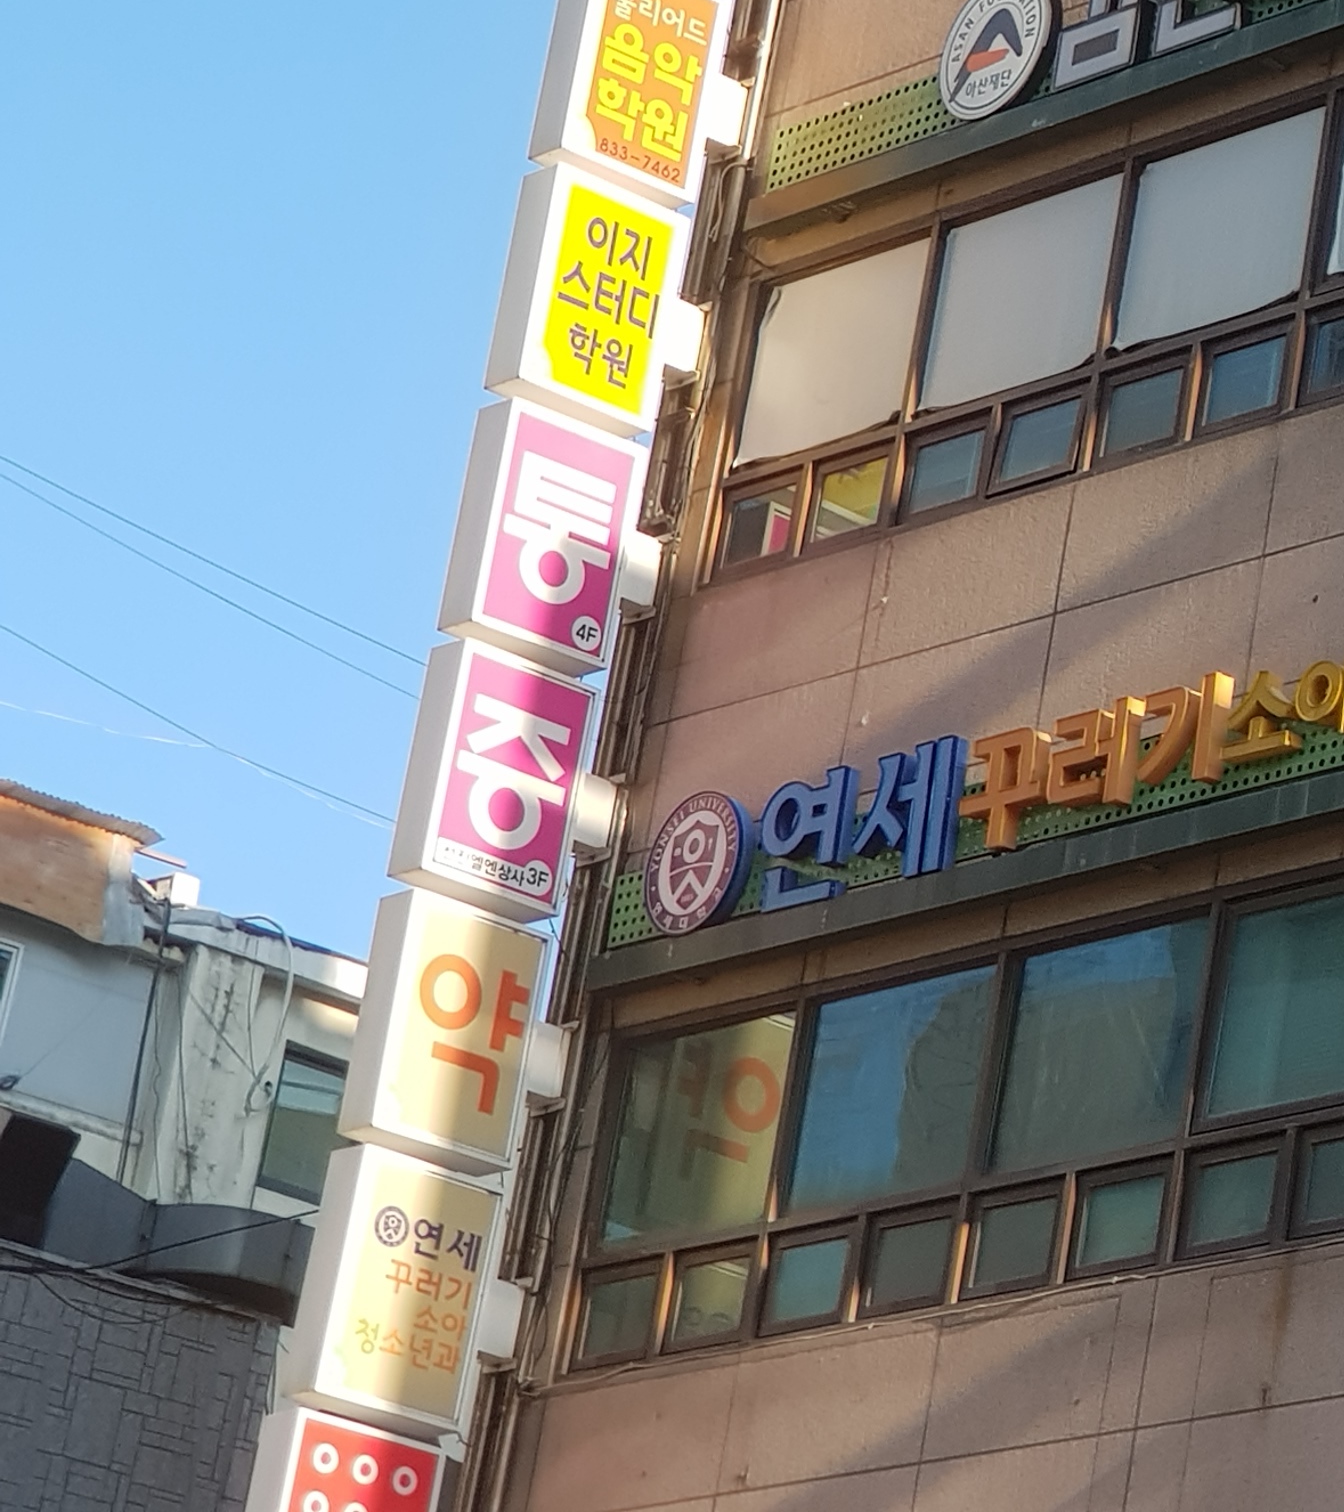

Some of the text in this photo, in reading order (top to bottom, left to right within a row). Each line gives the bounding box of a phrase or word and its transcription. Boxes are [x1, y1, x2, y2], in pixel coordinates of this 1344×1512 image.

[604, 22, 702, 106] 음악
[595, 76, 689, 163] 학원
[599, 137, 681, 184] 833-7462
[586, 216, 653, 282] 이지
[556, 260, 661, 340] 스터디
[568, 322, 634, 390] 학원
[503, 450, 617, 605] 통
[576, 625, 599, 643] 4F
[456, 692, 572, 850] 증
[419, 952, 530, 1116] 약
[413, 1218, 483, 1274] 연세
[413, 1305, 467, 1342] 소아
